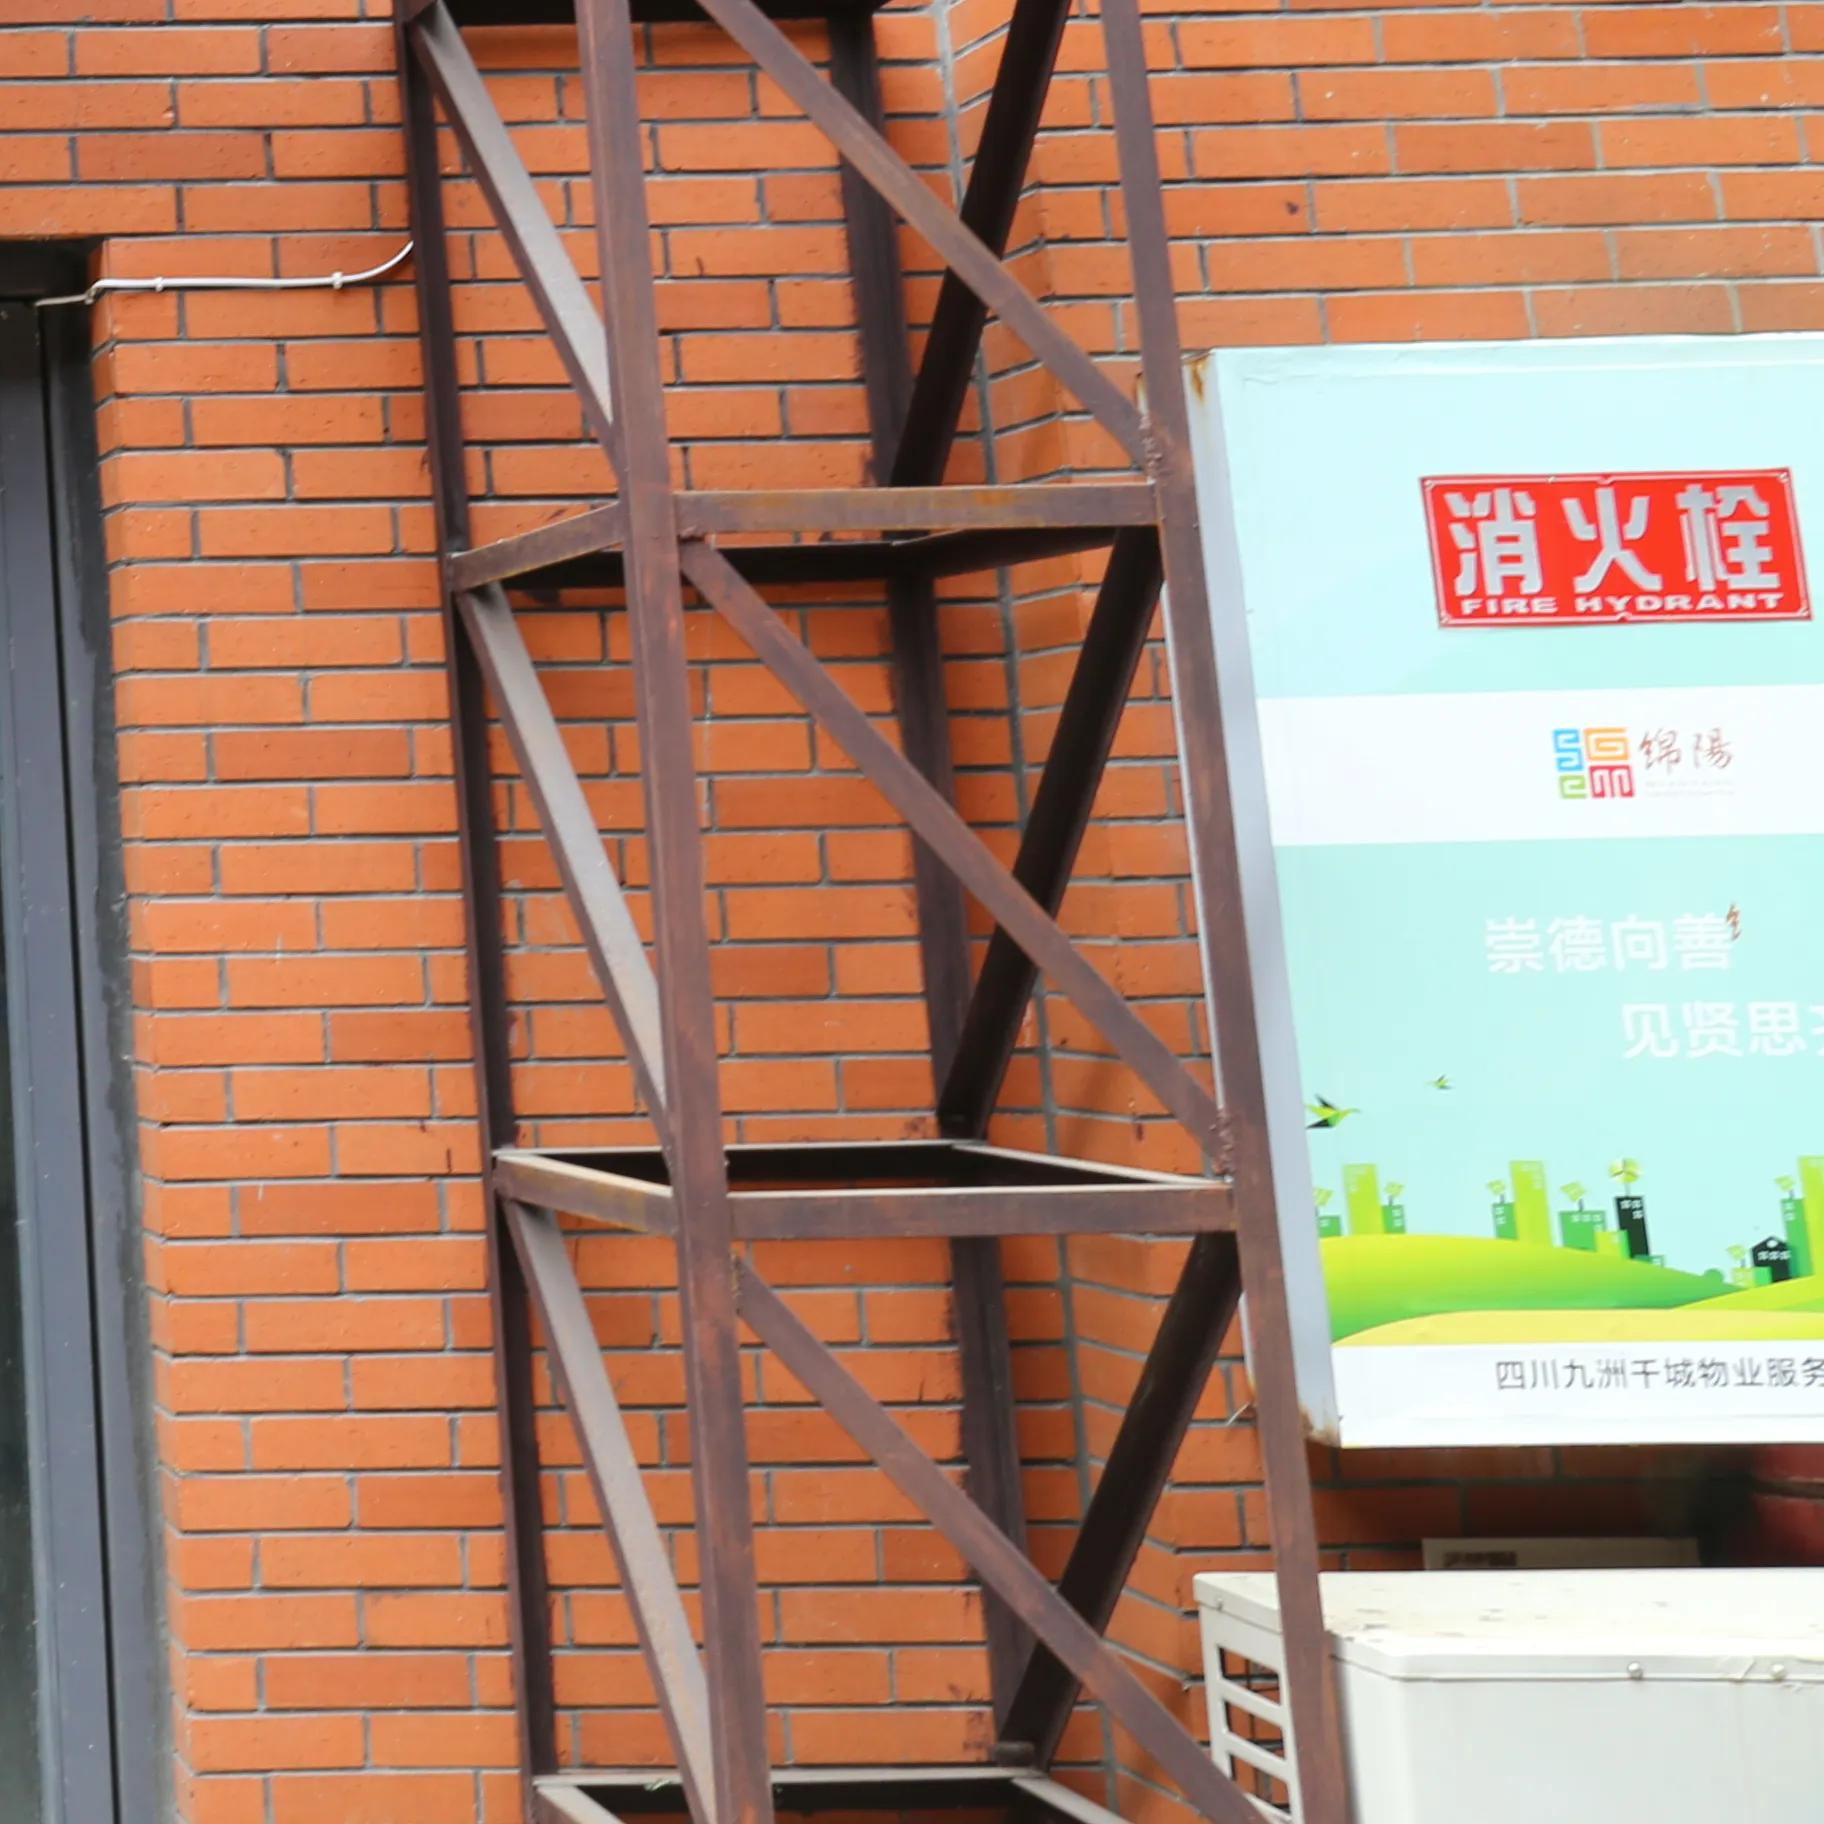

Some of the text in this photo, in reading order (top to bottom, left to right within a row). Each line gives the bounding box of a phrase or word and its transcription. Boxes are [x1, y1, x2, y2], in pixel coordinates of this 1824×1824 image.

[1444, 484, 1781, 596] 消火栓
[1461, 593, 1784, 616] FIRE HYDRANT
[1484, 912, 1735, 973] 崇德向善
